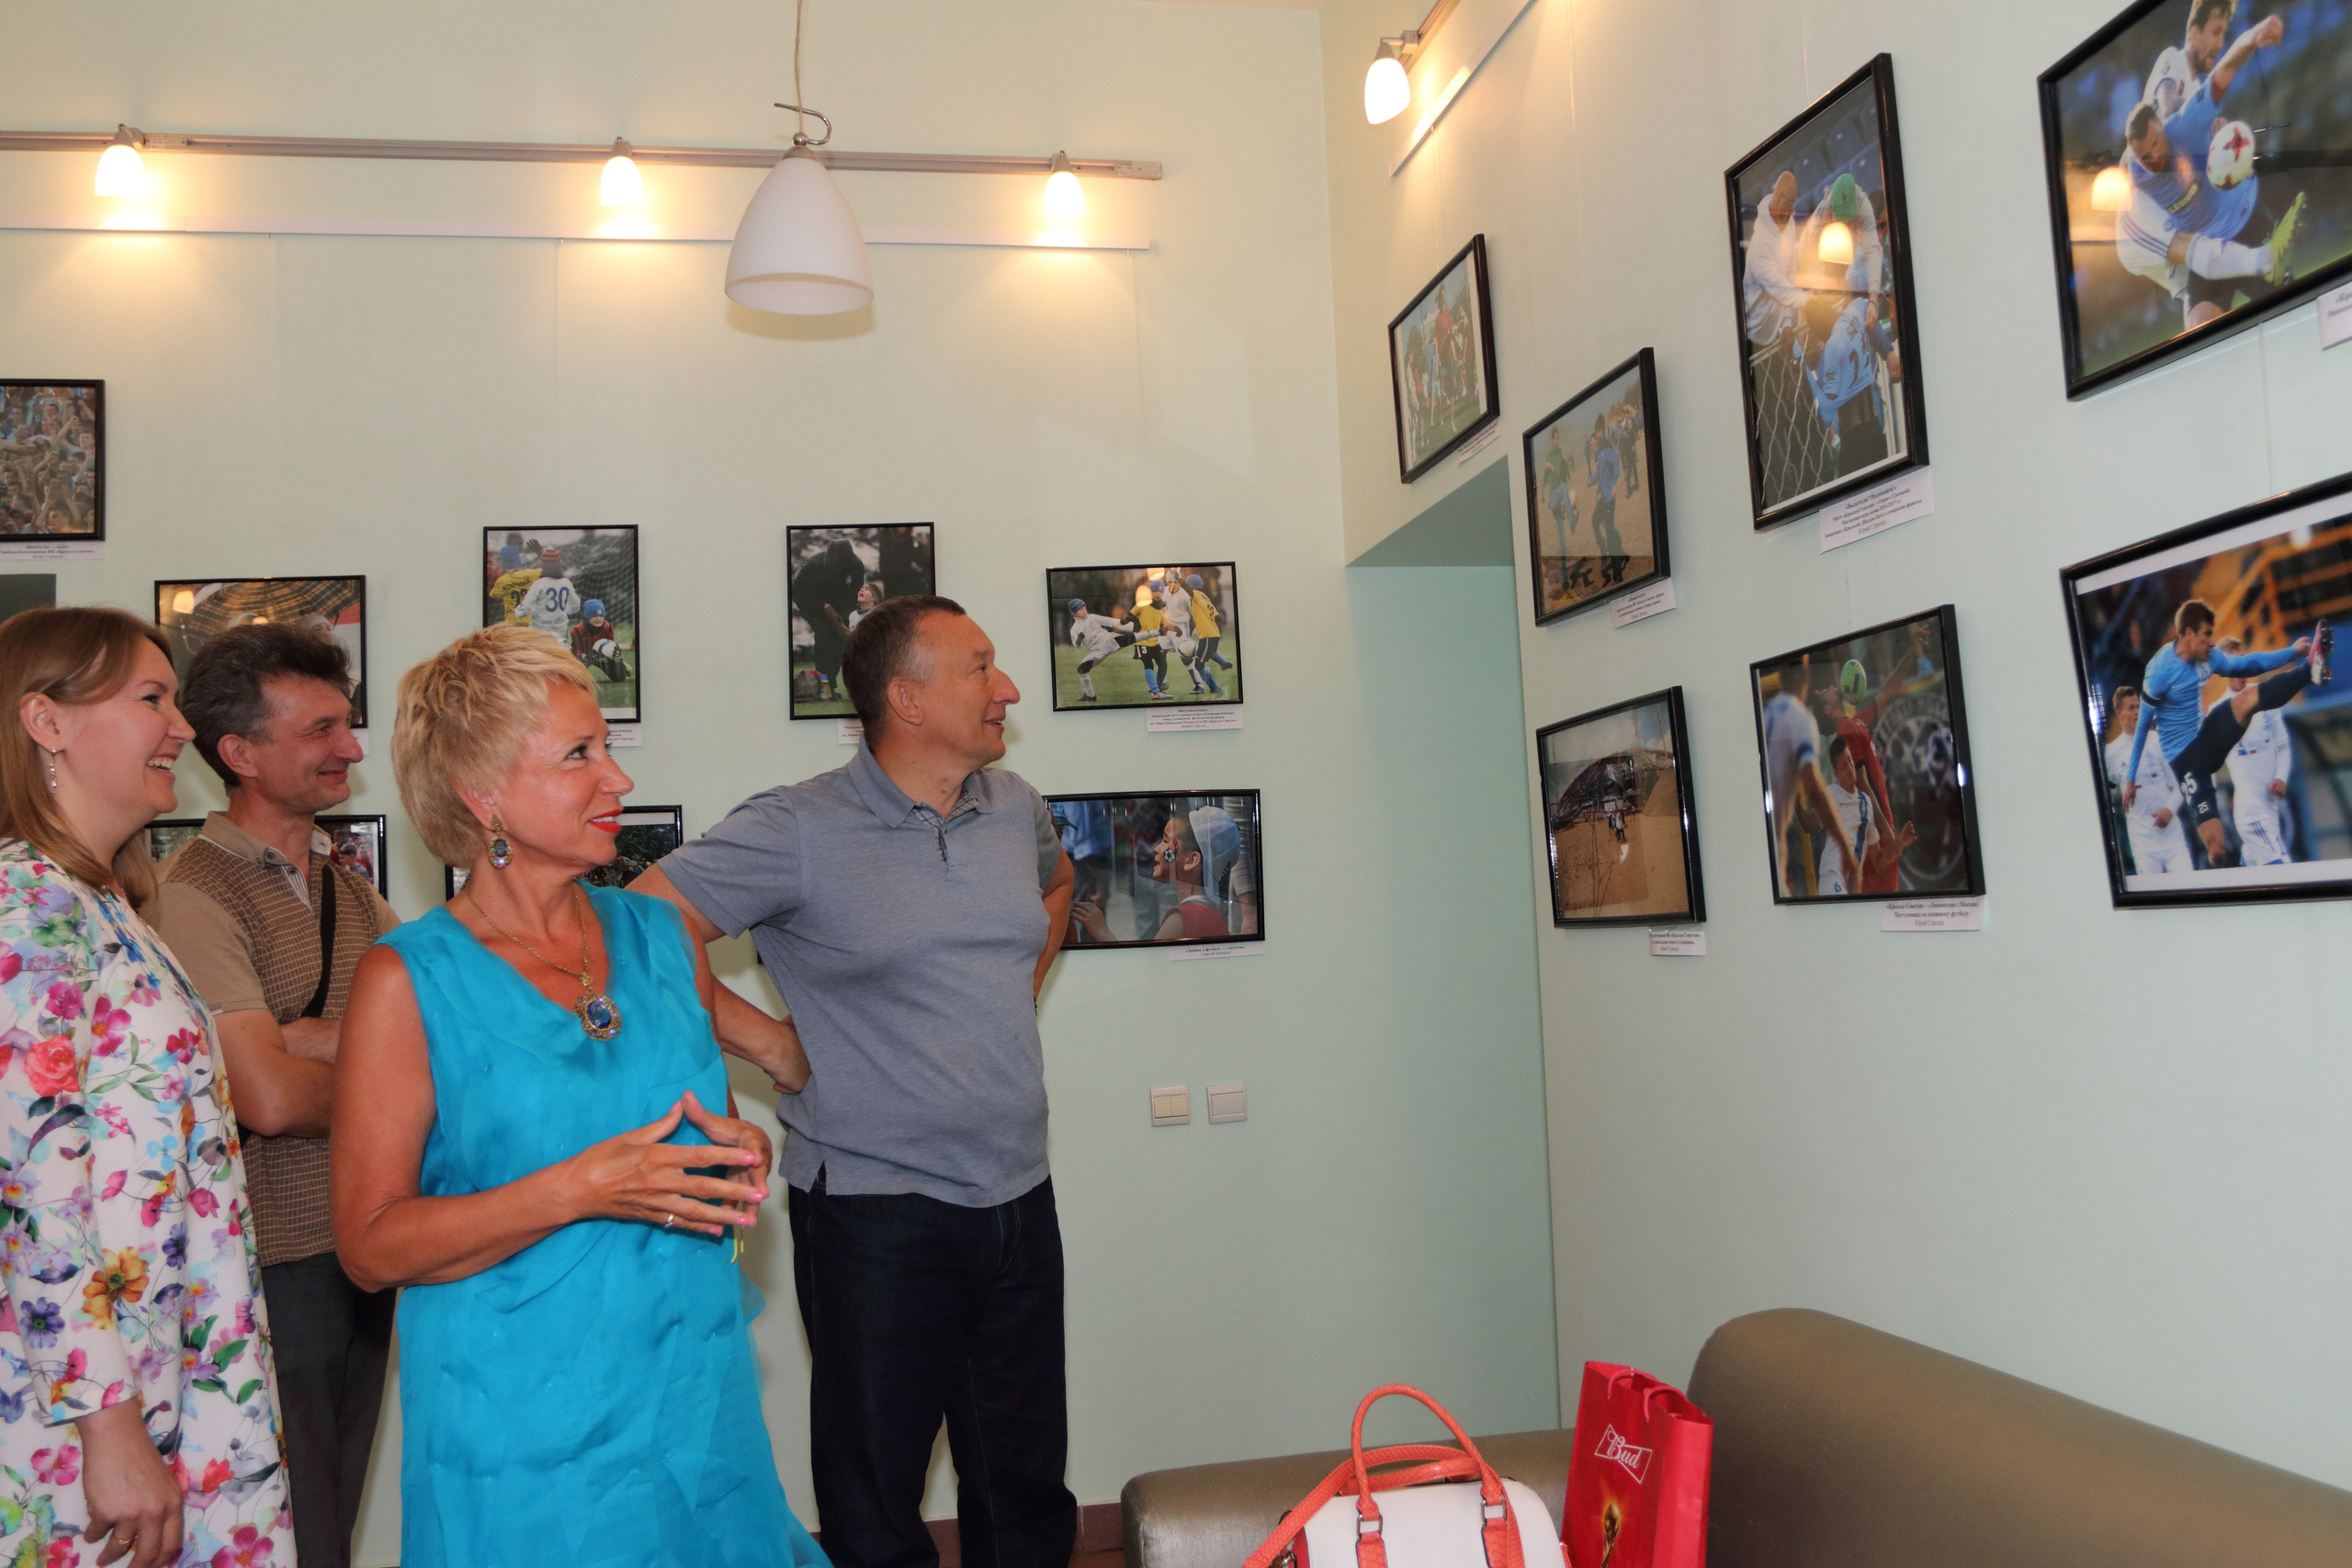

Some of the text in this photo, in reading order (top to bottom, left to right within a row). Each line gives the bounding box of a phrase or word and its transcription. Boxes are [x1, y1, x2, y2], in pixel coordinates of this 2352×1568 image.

[545, 586, 570, 612] 30
[1834, 881, 1841, 893] 6
[1607, 1429, 1642, 1469] Bud
